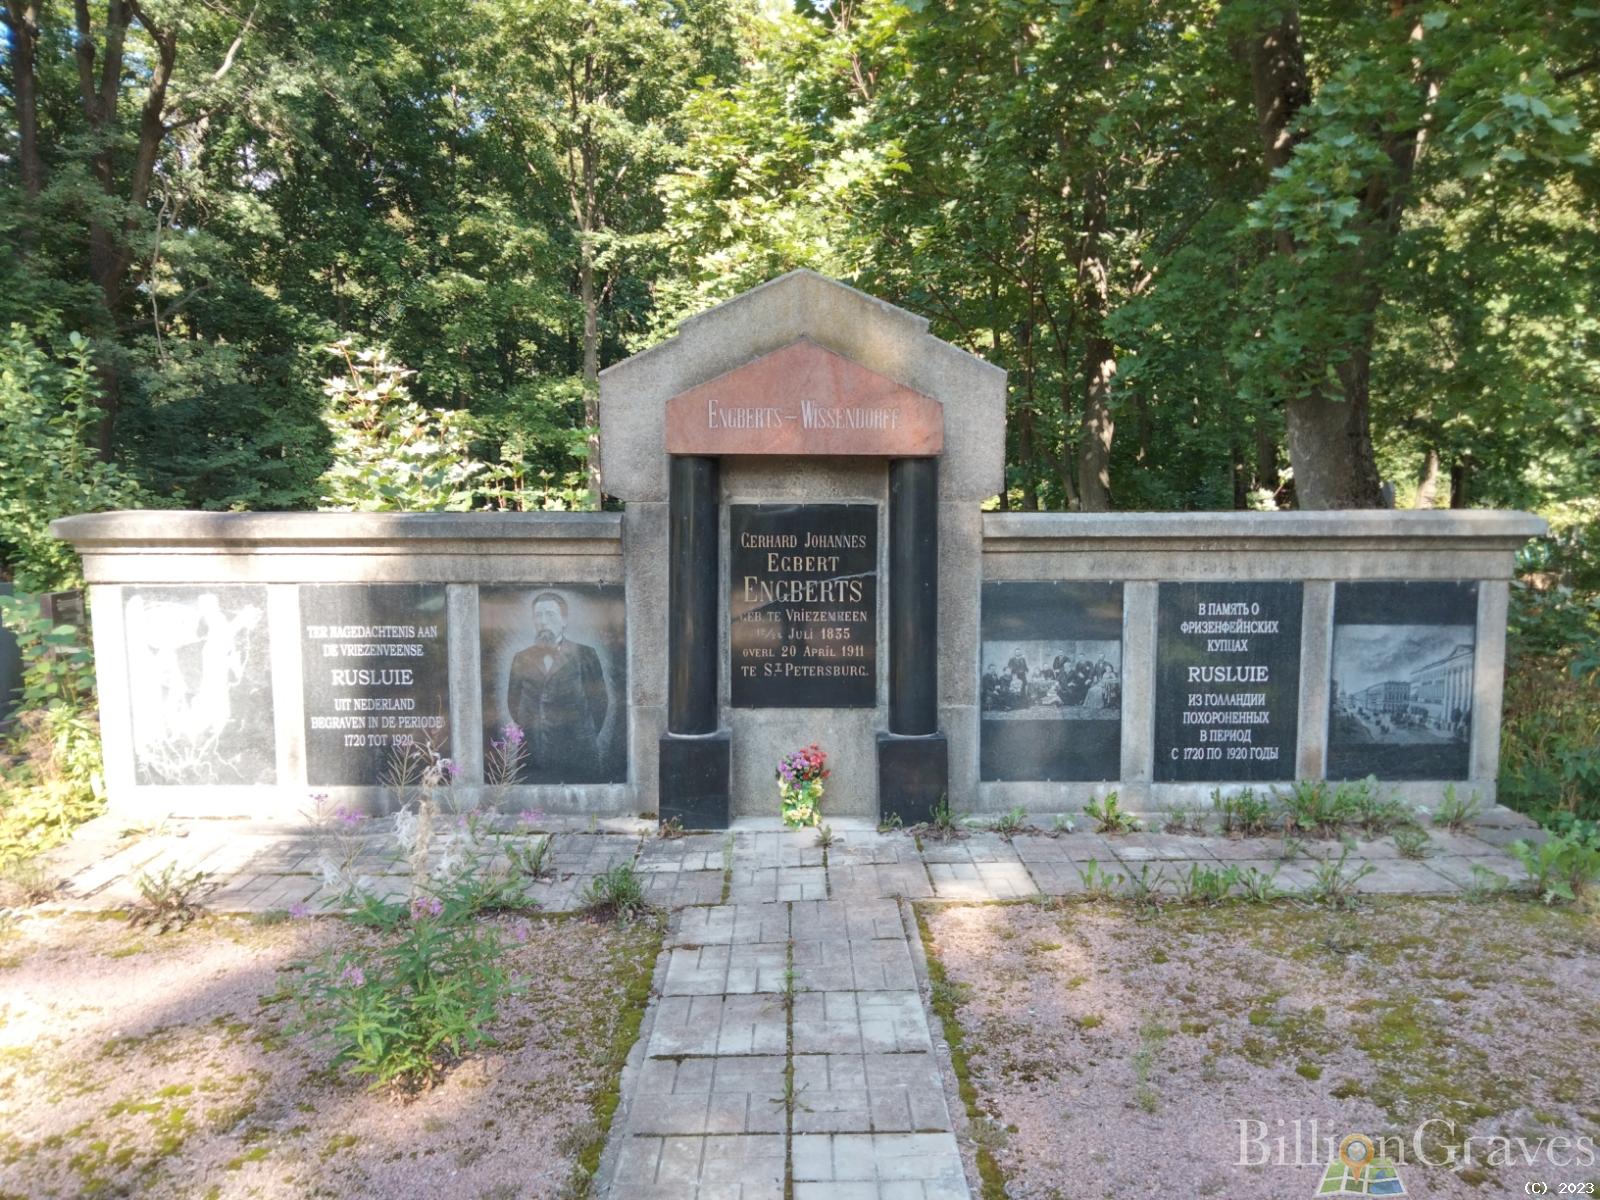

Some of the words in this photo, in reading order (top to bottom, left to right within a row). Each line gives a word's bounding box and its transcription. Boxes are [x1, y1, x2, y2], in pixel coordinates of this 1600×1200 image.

[741, 531, 798, 548] GERHARD
[804, 532, 867, 548] JOHANNES
[767, 552, 840, 572] EGBERT
[744, 576, 863, 603] ENGBERTS
[1198, 603, 1206, 615] В
[1208, 603, 1249, 615] ПАМЯТЬ
[1251, 602, 1260, 615] О
[767, 611, 781, 622] TE
[306, 625, 328, 638] TER
[417, 626, 438, 638] AAN
[1180, 619, 1279, 634] ФРИЗЕНФЕЙНСКИХ
[788, 628, 813, 640] JULI
[322, 644, 338, 657] DE
[340, 644, 424, 657] VRIEZENVEENSE
[781, 645, 797, 658] 20
[803, 645, 836, 657] APRIL
[841, 645, 865, 657] 1911
[1207, 639, 1248, 653] КУПЦАХ
[331, 669, 414, 686] RUSLUIE
[741, 665, 757, 677] TE
[1188, 666, 1269, 683] RUSLUIE
[334, 698, 352, 711] UIT
[354, 698, 415, 711] NEDERLAND
[1188, 694, 1202, 706] ИЗ
[1204, 694, 1266, 707] ГОЛЛАНДИИ
[311, 716, 366, 729] BEGRAVEN
[368, 717, 379, 729] IN
[381, 717, 396, 729] DE
[398, 717, 443, 729] PERIODE
[1183, 712, 1270, 724] ПОХОРОНЕННЫХ
[344, 735, 366, 747] 1720
[367, 735, 388, 747] TOT
[392, 735, 414, 747] 1920
[1200, 730, 1207, 742] В
[1209, 730, 1252, 744] ПЕРИОД
[1171, 748, 1179, 760] С
[1183, 748, 1204, 760] 1720
[1206, 748, 1222, 760] ПО
[1226, 748, 1248, 760] 1920
[1250, 747, 1279, 761] ГОДЫ
